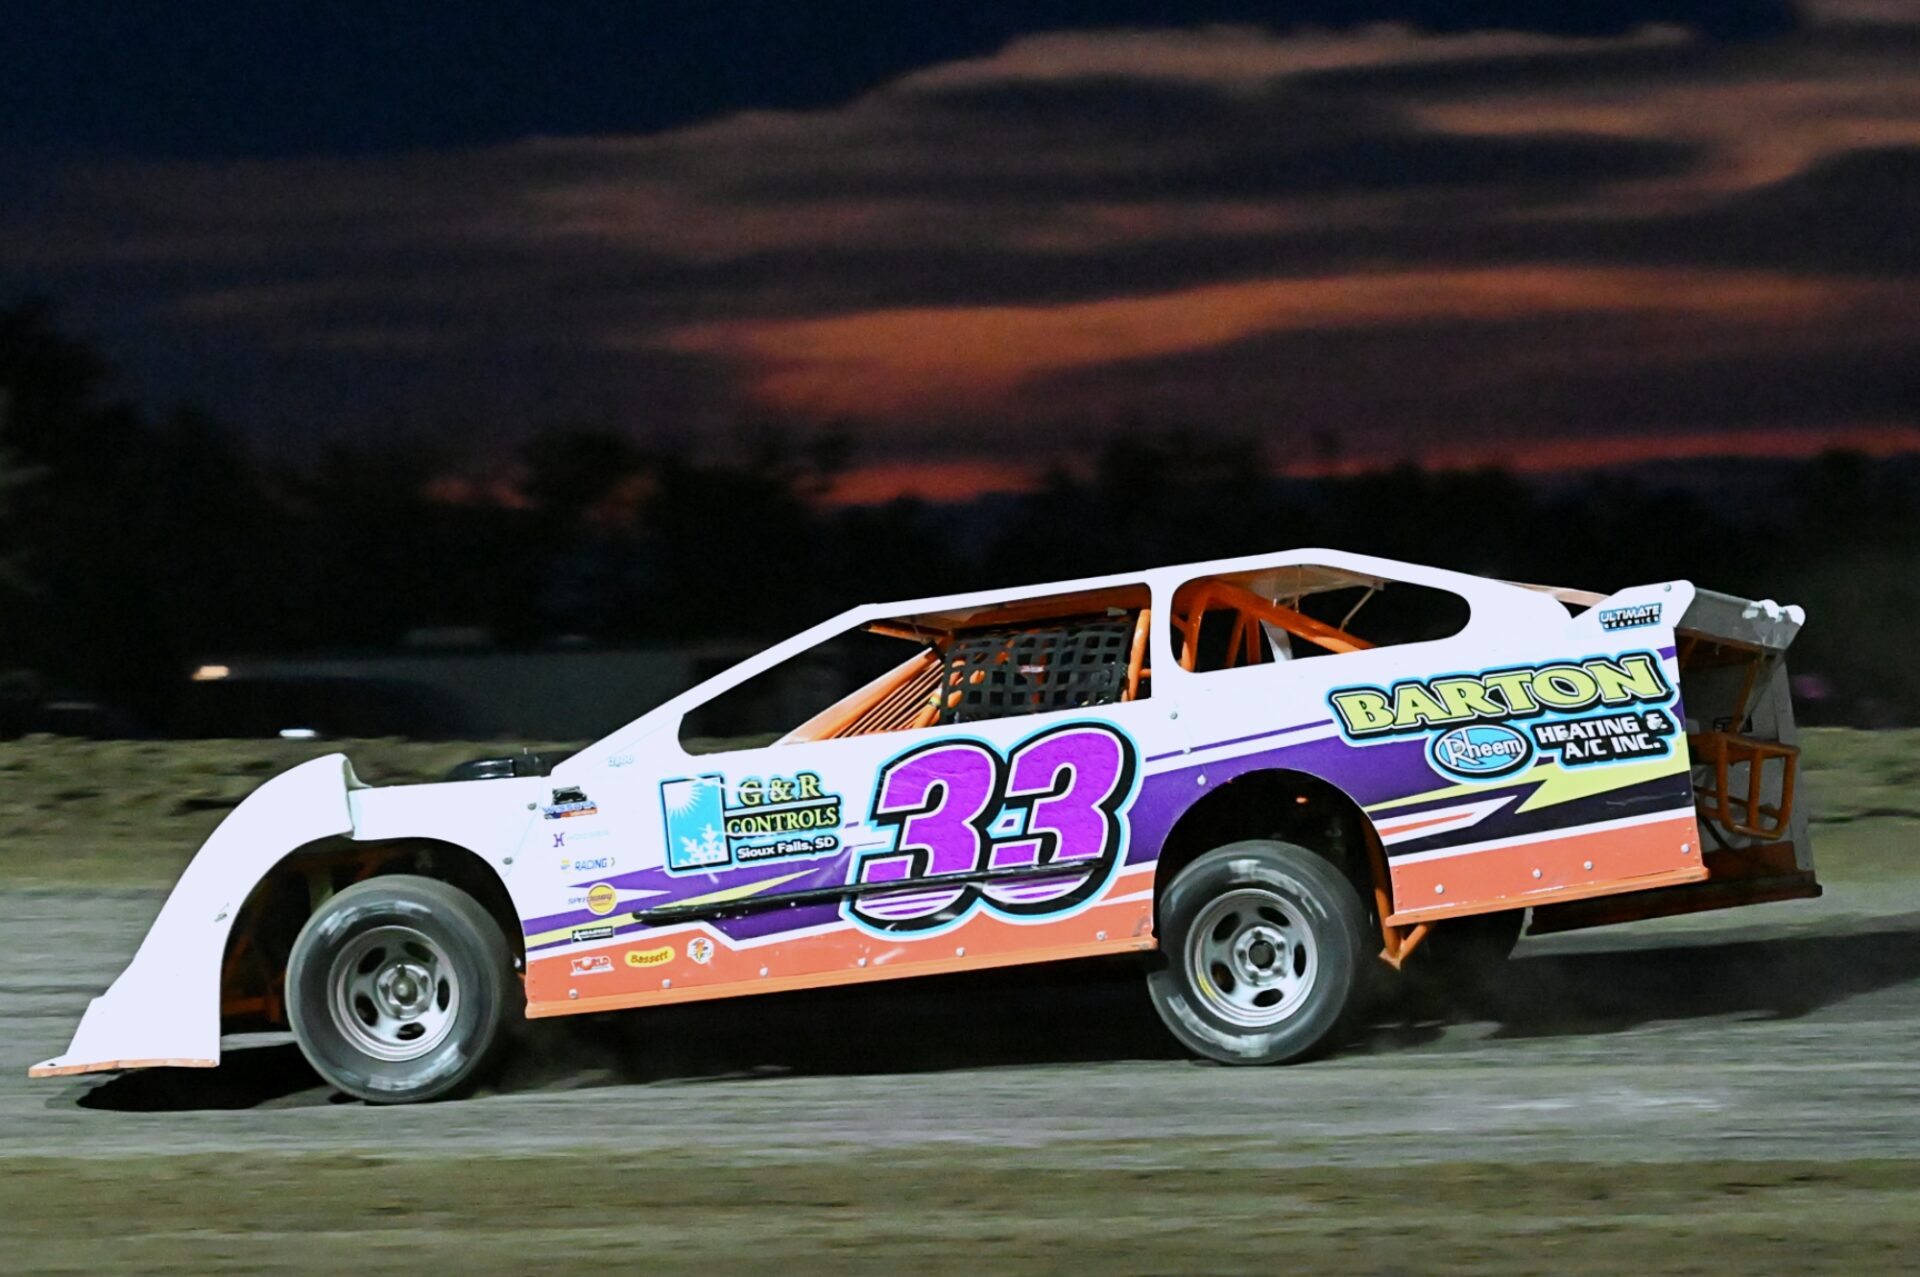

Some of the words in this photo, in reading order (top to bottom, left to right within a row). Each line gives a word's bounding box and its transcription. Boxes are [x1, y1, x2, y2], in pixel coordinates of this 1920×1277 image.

[1600, 605, 1660, 622] ULTIMATE
[1333, 657, 1665, 733] BARTON
[1535, 716, 1640, 743] HEATING
[1446, 728, 1523, 766] Rheem
[1565, 737, 1605, 759] A/C
[1612, 733, 1661, 753] INC.
[740, 780, 762, 806] G
[770, 778, 794, 802] &
[798, 774, 821, 798] R
[727, 807, 838, 834] CONTROLS
[852, 725, 1130, 922] 33
[737, 847, 776, 859] Sioux
[777, 841, 814, 854] Falls,
[815, 837, 836, 849] SD
[631, 951, 669, 963] Bassett
